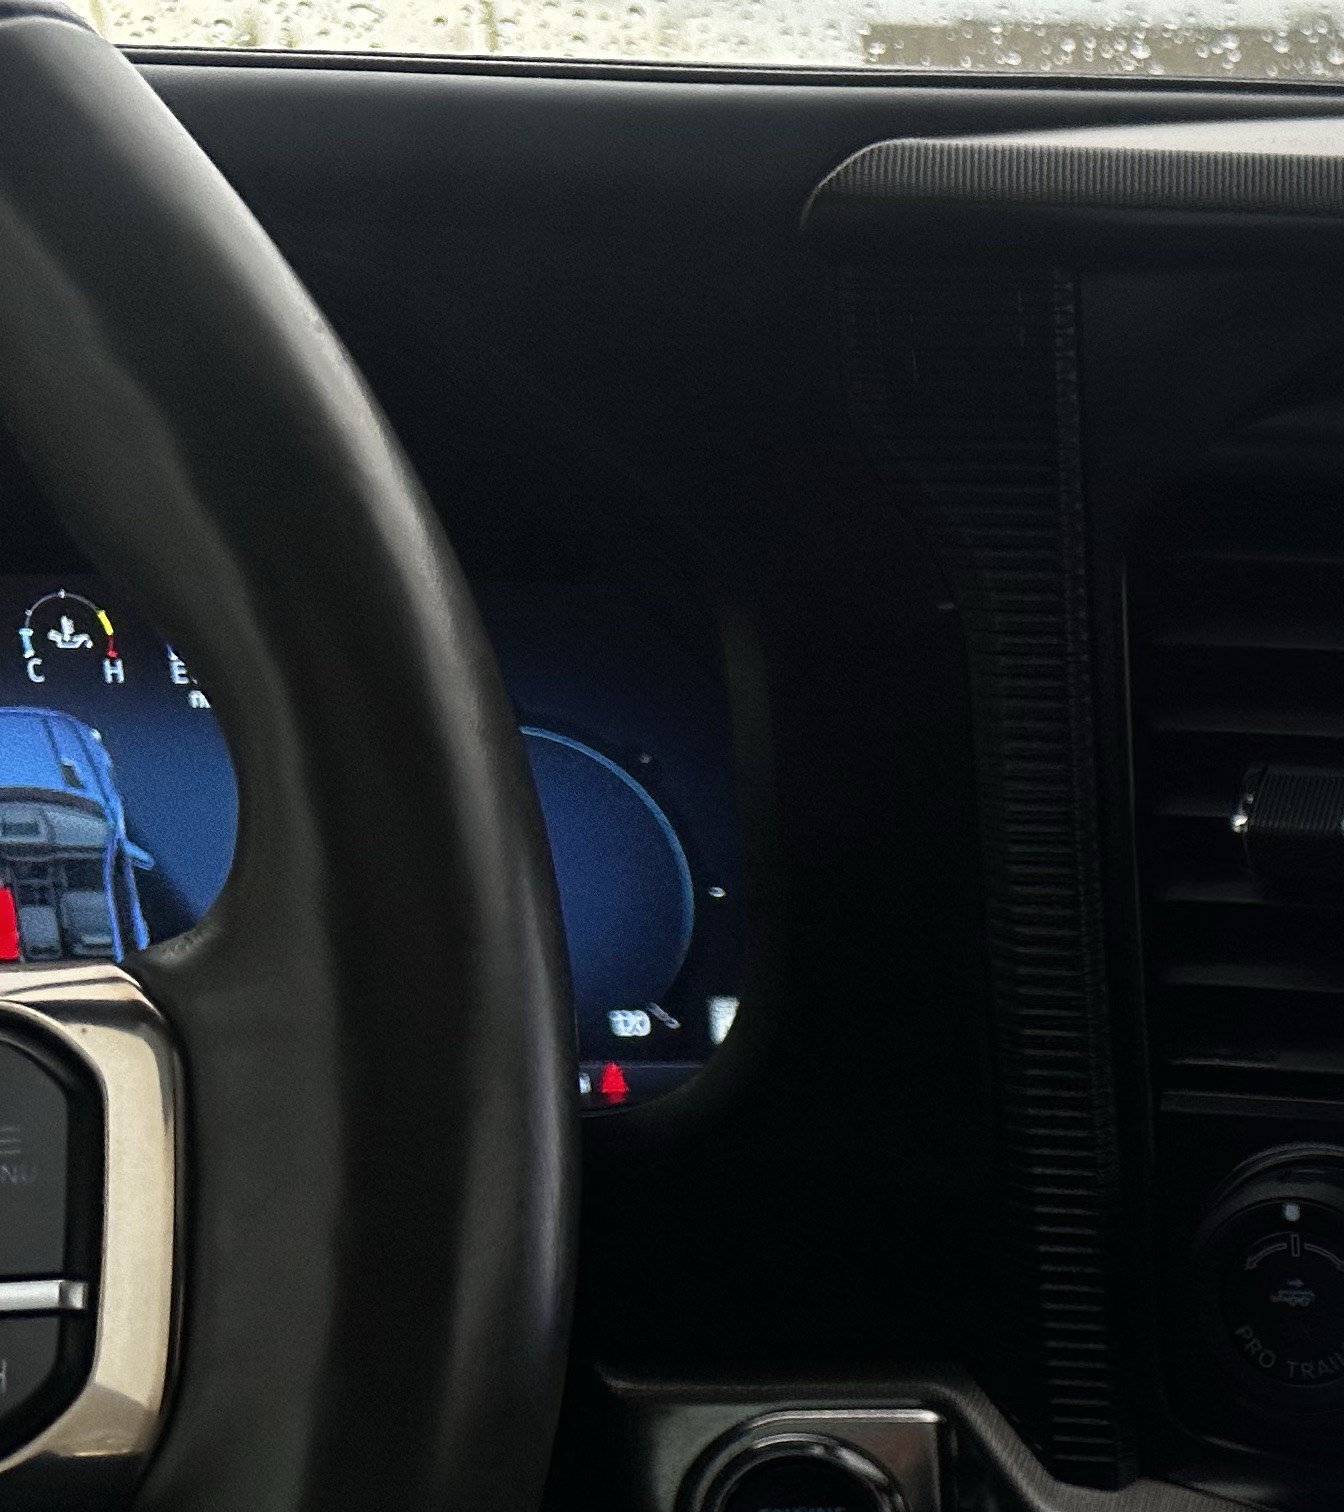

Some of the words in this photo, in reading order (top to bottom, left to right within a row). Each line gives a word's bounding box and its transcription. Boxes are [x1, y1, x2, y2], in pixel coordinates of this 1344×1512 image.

[27, 658, 45, 683] C
[103, 658, 125, 684] H
[169, 660, 190, 684] E
[1233, 1323, 1278, 1370] PRO
